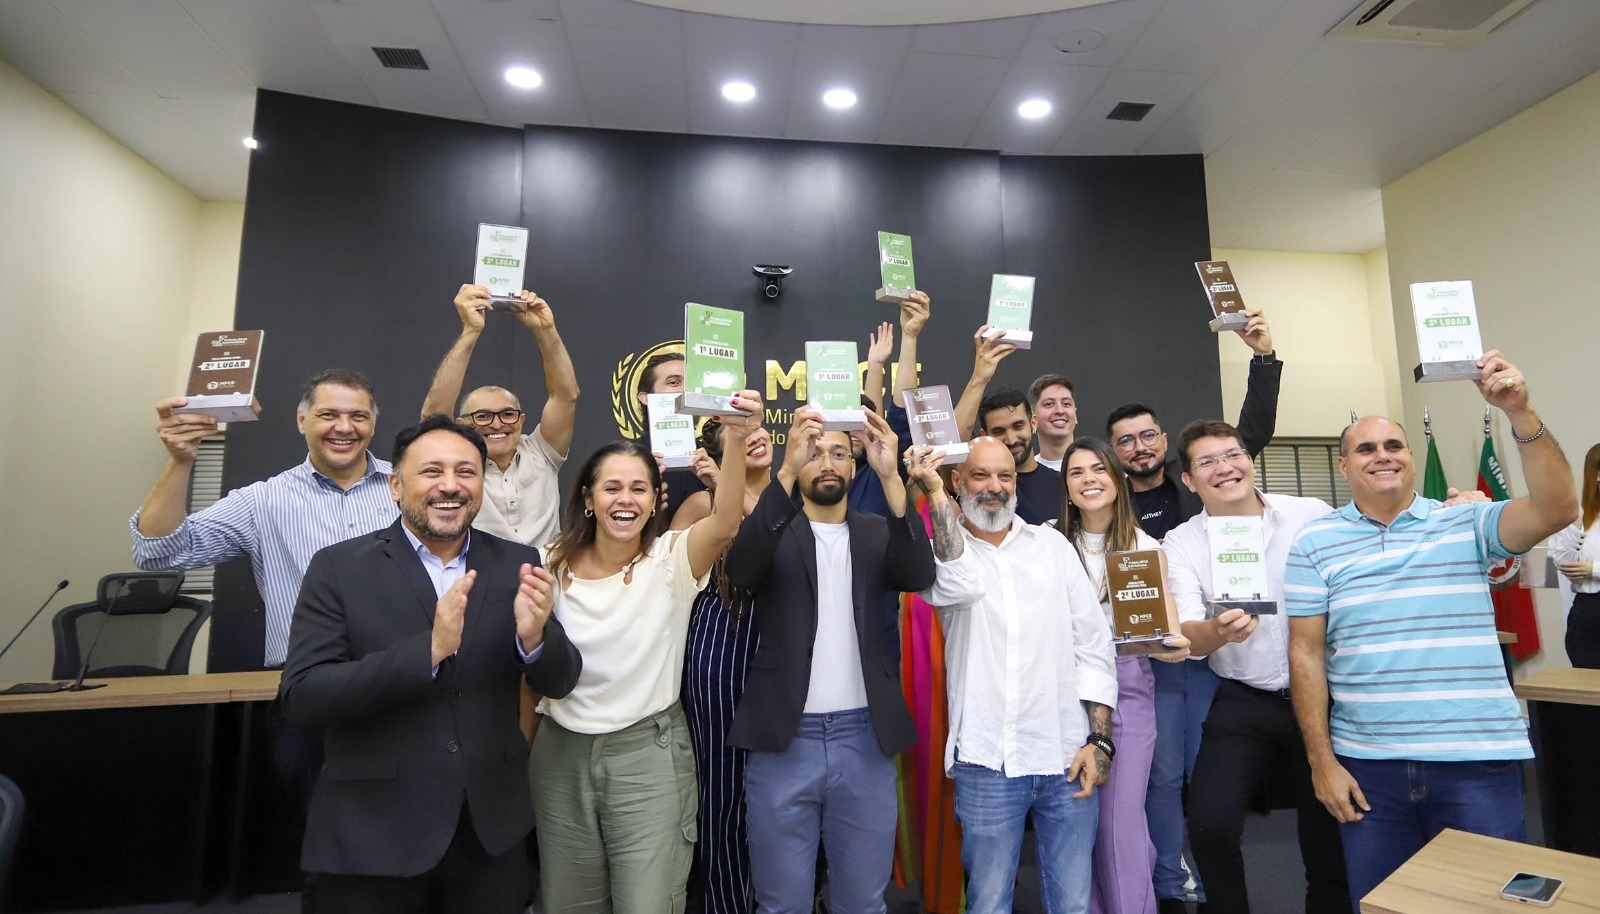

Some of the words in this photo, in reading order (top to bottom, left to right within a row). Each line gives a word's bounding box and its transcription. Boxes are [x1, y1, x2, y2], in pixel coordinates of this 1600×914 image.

[495, 258, 518, 267] LUGAR
[1439, 317, 1468, 326] LUGAR
[700, 345, 706, 354] 1º
[709, 347, 735, 358] LUGAR
[217, 361, 246, 369] LUGAR
[926, 413, 947, 421] LUGAR
[666, 421, 687, 429] LUGAR
[1231, 554, 1256, 562] LUGAR
[1121, 591, 1129, 600] 2º
[1131, 589, 1156, 599] LUGAR
